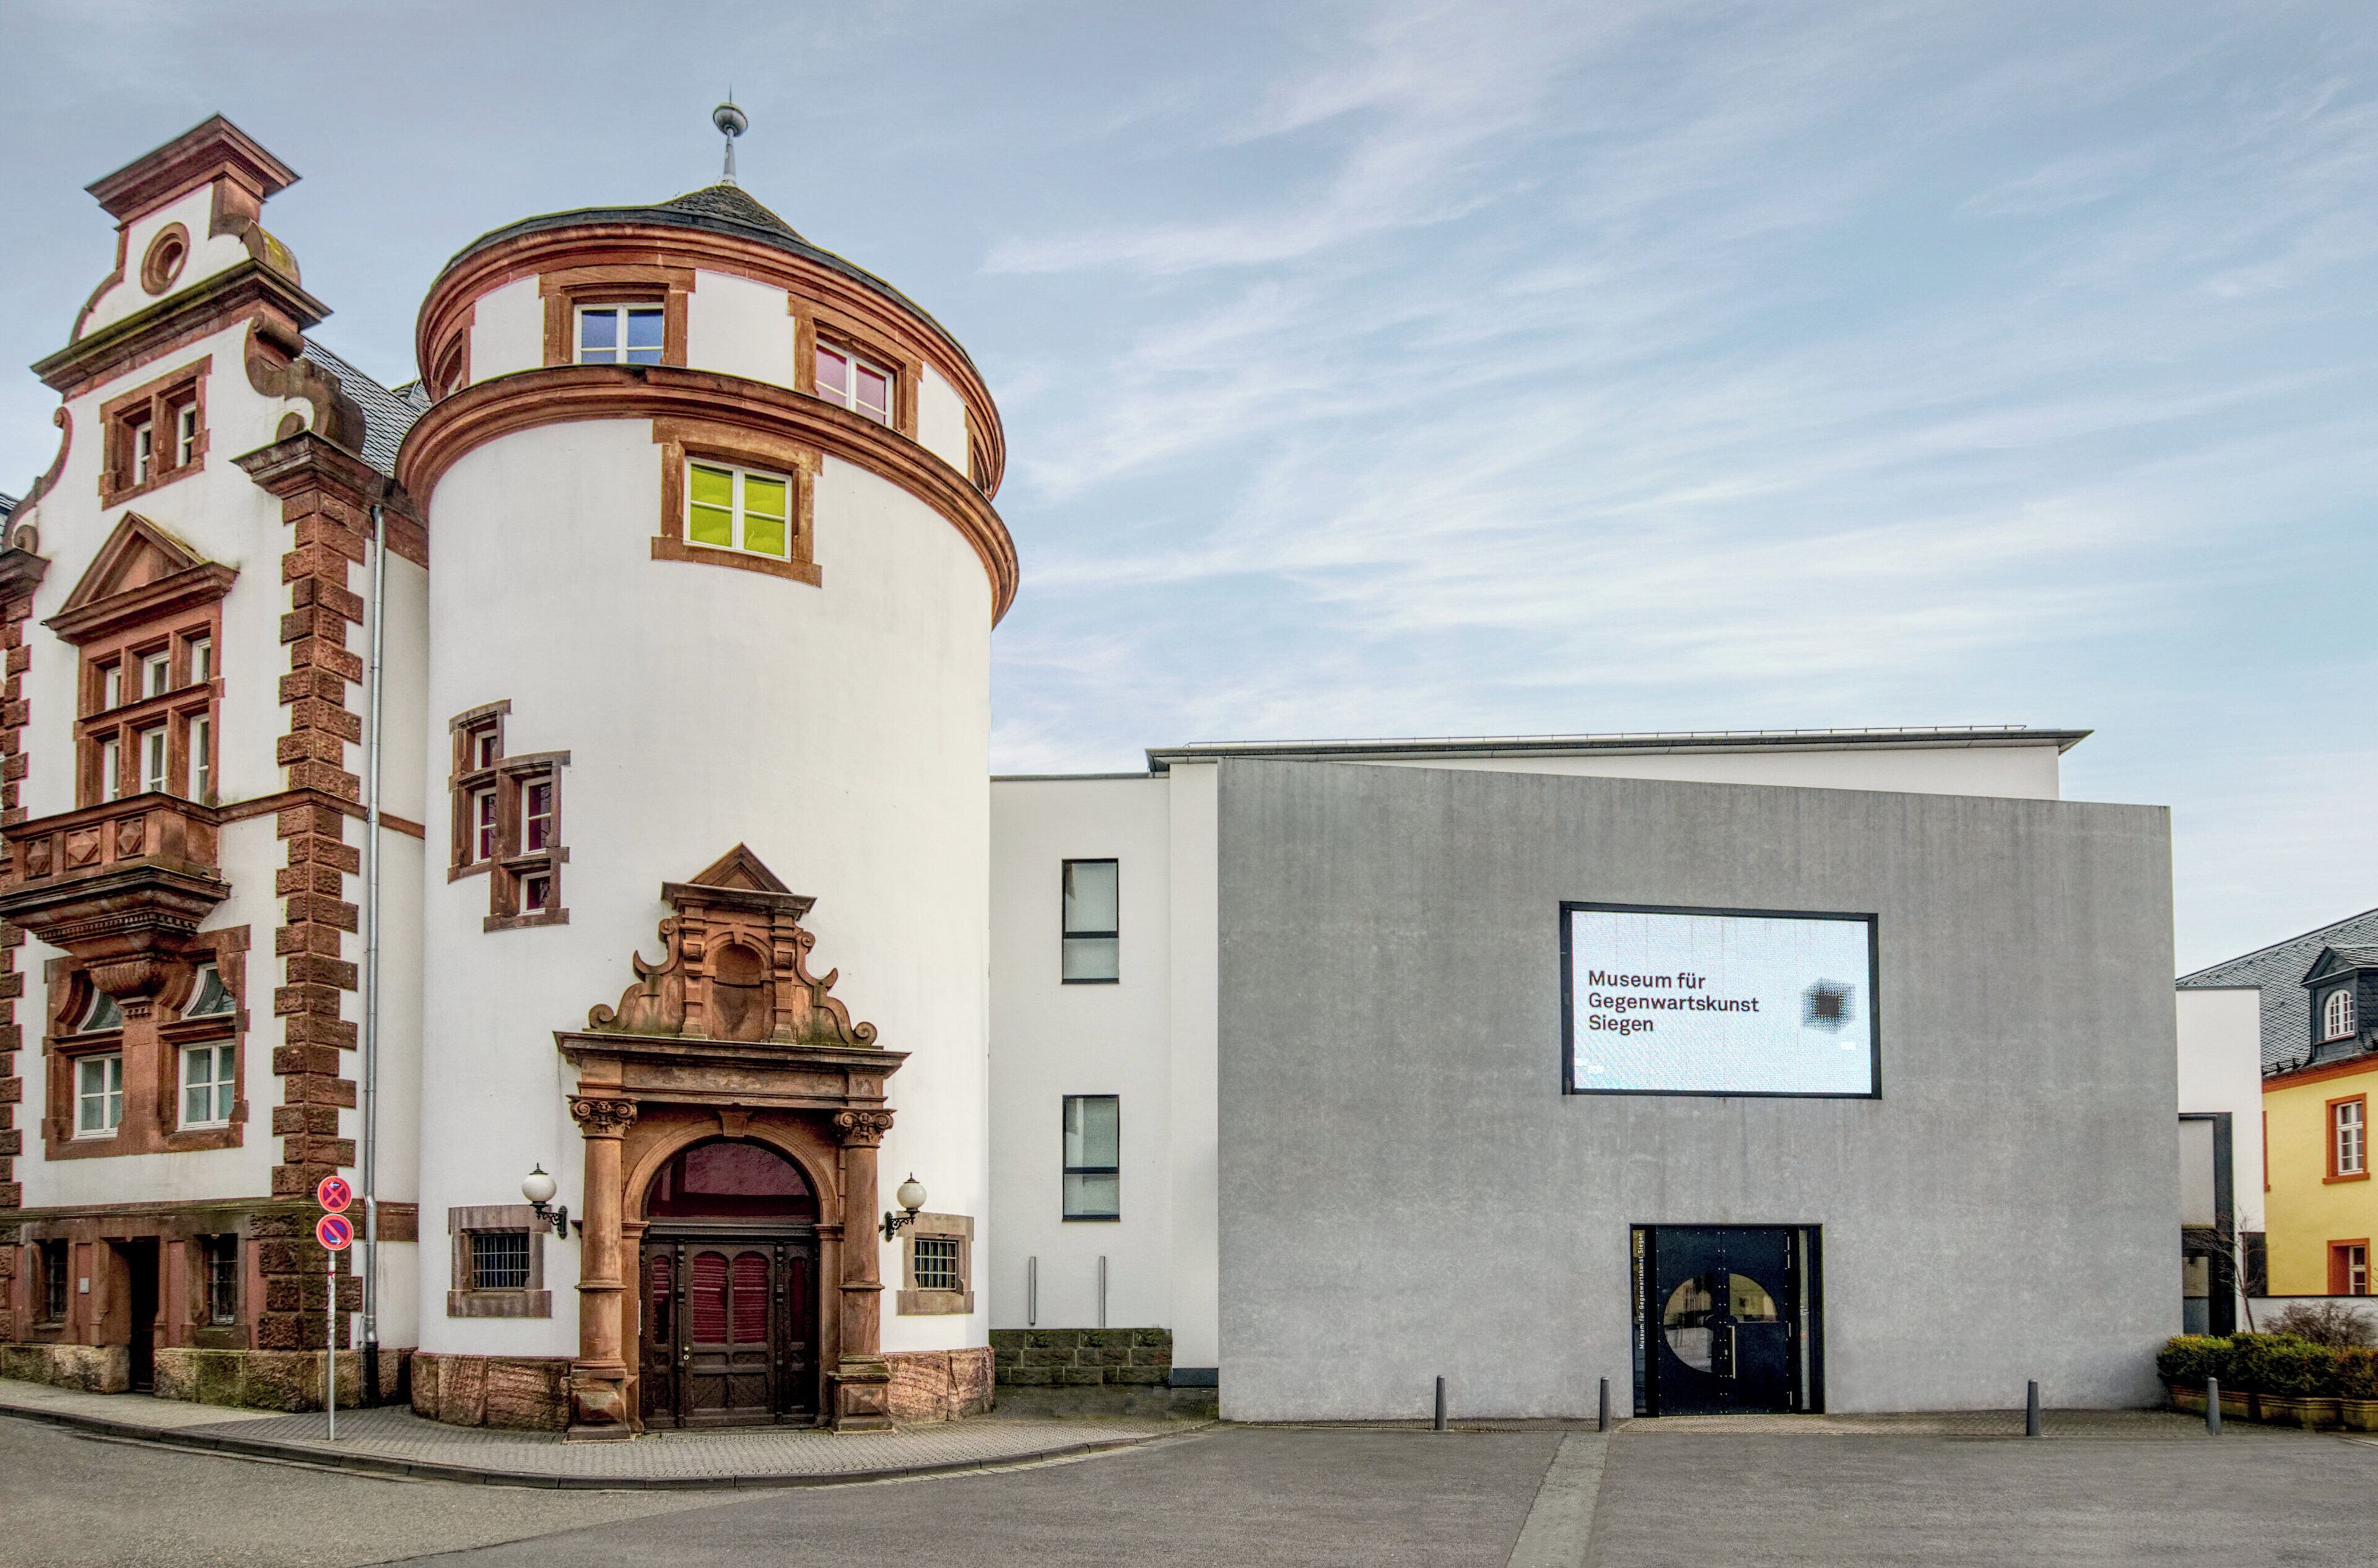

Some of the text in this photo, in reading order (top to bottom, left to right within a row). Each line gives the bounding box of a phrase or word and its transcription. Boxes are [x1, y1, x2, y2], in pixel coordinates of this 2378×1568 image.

[1588, 970, 1707, 990] Museum für
[1588, 992, 1760, 1013] Gegenwartskunst
[1588, 1014, 1654, 1036] Siegen
[1637, 1232, 1645, 1254] Siegen
[1638, 1256, 1646, 1310] Gegenwartskunst
